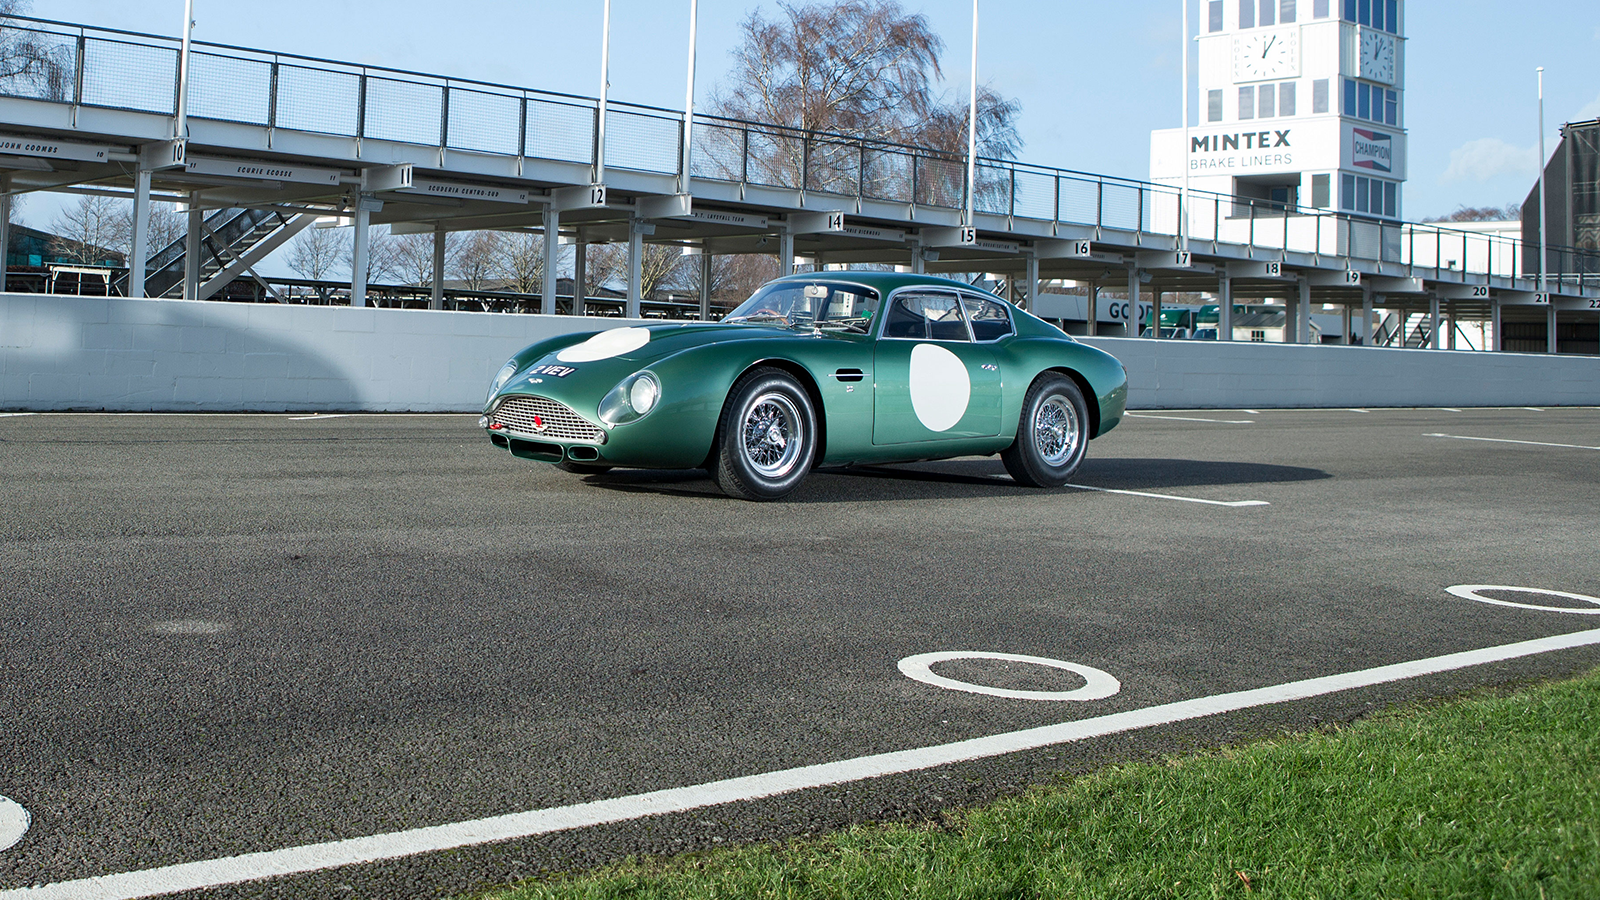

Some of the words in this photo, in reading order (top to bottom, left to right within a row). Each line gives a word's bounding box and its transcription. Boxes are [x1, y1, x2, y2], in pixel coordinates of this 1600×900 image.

[1191, 129, 1291, 153] MINTEX
[0, 142, 21, 150] JOHN
[25, 144, 58, 153] COOMBS
[173, 145, 183, 162] 10
[1355, 141, 1390, 159] CHAMPION
[1190, 157, 1235, 170] BRAKE
[1241, 153, 1293, 167] LINERS
[237, 166, 263, 175] ECURIE
[266, 169, 293, 177] ECOSSE
[400, 167, 410, 185] 11
[428, 185, 459, 193] SCUDERIA
[461, 188, 499, 198] CENTRO-SUD
[591, 189, 604, 204] 12
[828, 214, 842, 229] 14
[961, 230, 974, 242] 15
[1075, 242, 1088, 254] 16
[1175, 252, 1189, 264] 17
[1265, 263, 1279, 274] 18
[1346, 272, 1359, 282] 19
[1472, 286, 1487, 296] 20
[1535, 293, 1548, 303] 21
[529, 365, 546, 374] 2
[541, 365, 576, 377] VEV
